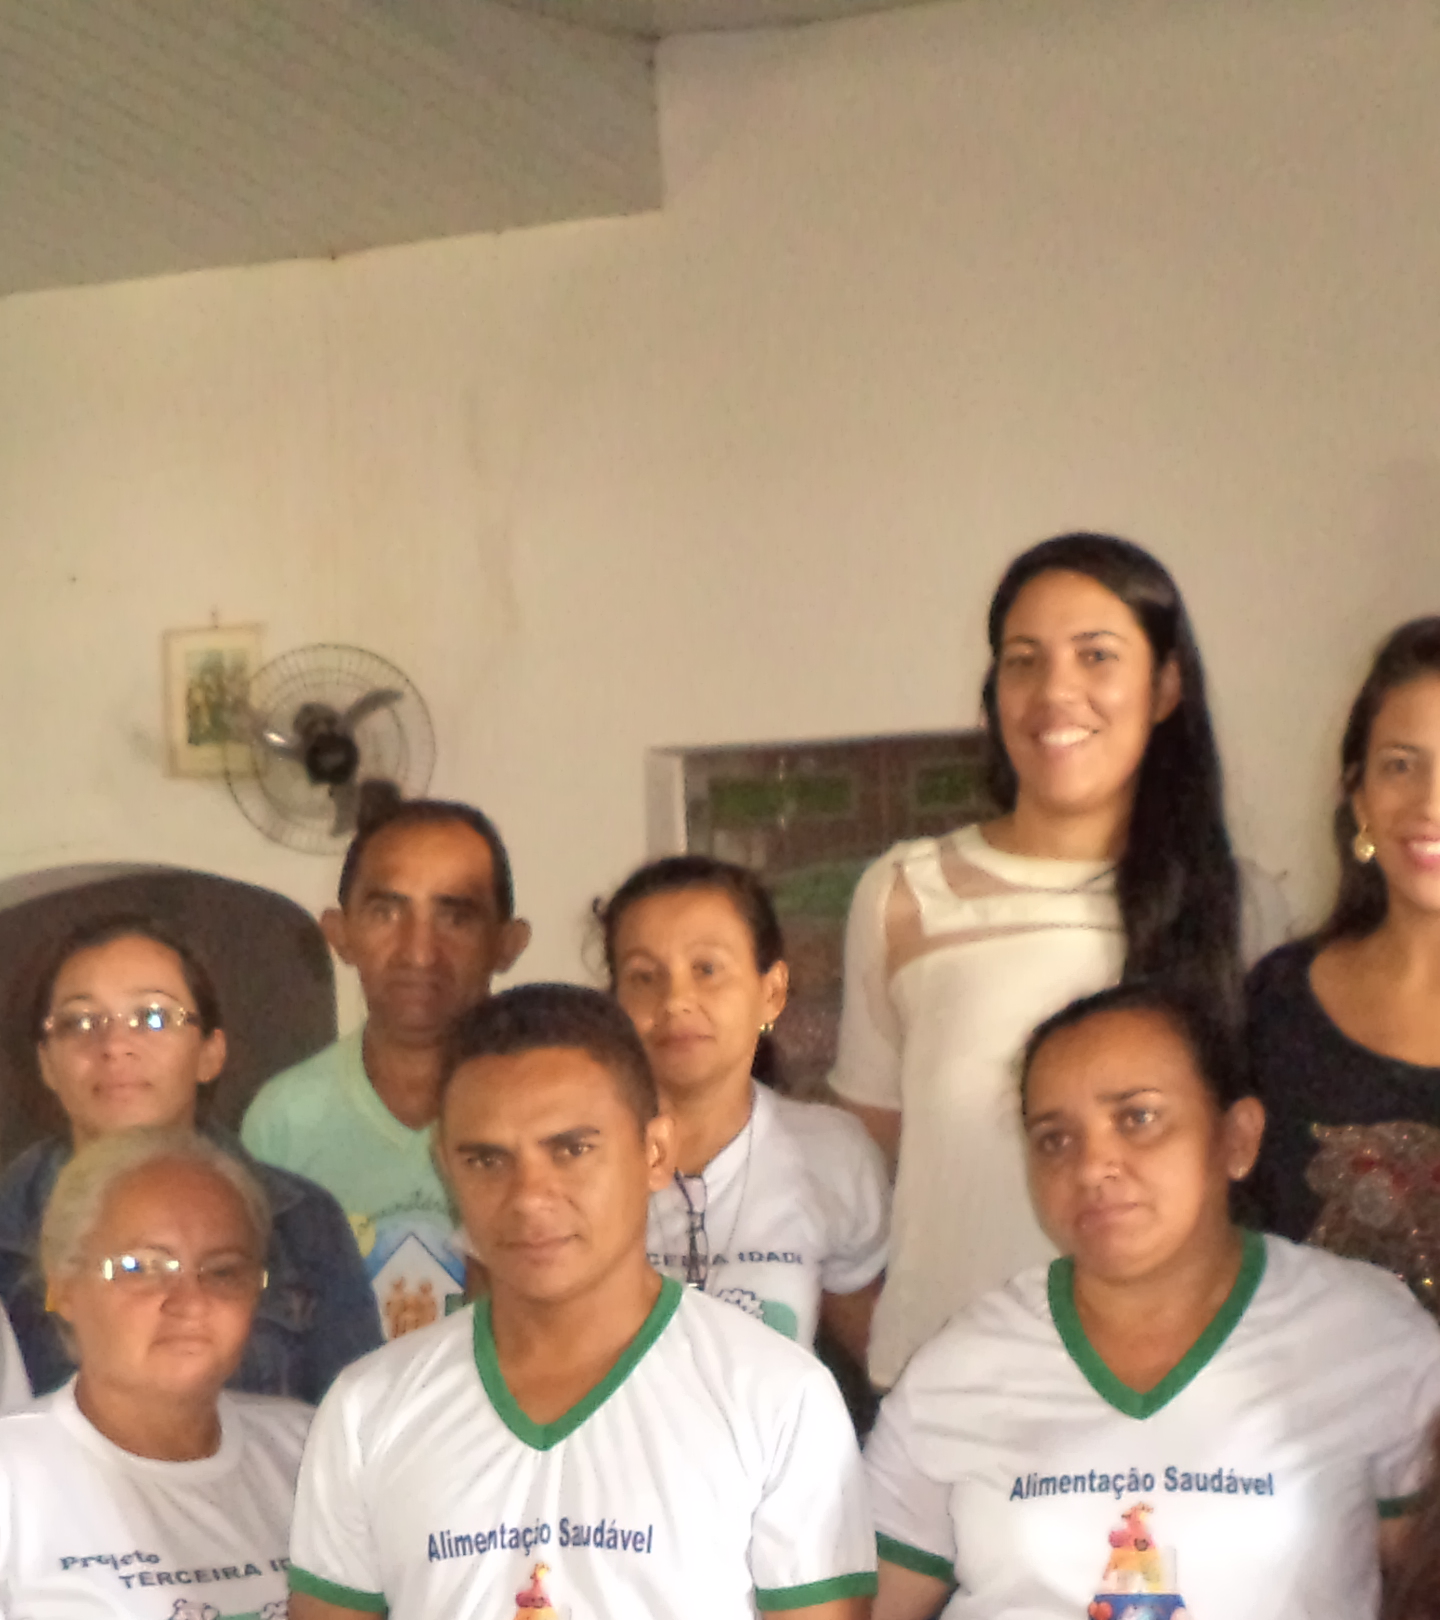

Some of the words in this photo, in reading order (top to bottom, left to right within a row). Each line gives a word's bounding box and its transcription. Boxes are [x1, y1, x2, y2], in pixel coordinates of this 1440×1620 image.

[1009, 1466, 1156, 1501] Alimentação
[1163, 1465, 1275, 1497] Saudável
[559, 1516, 654, 1554] Saudável
[118, 1562, 263, 1590] TERCEIRA
